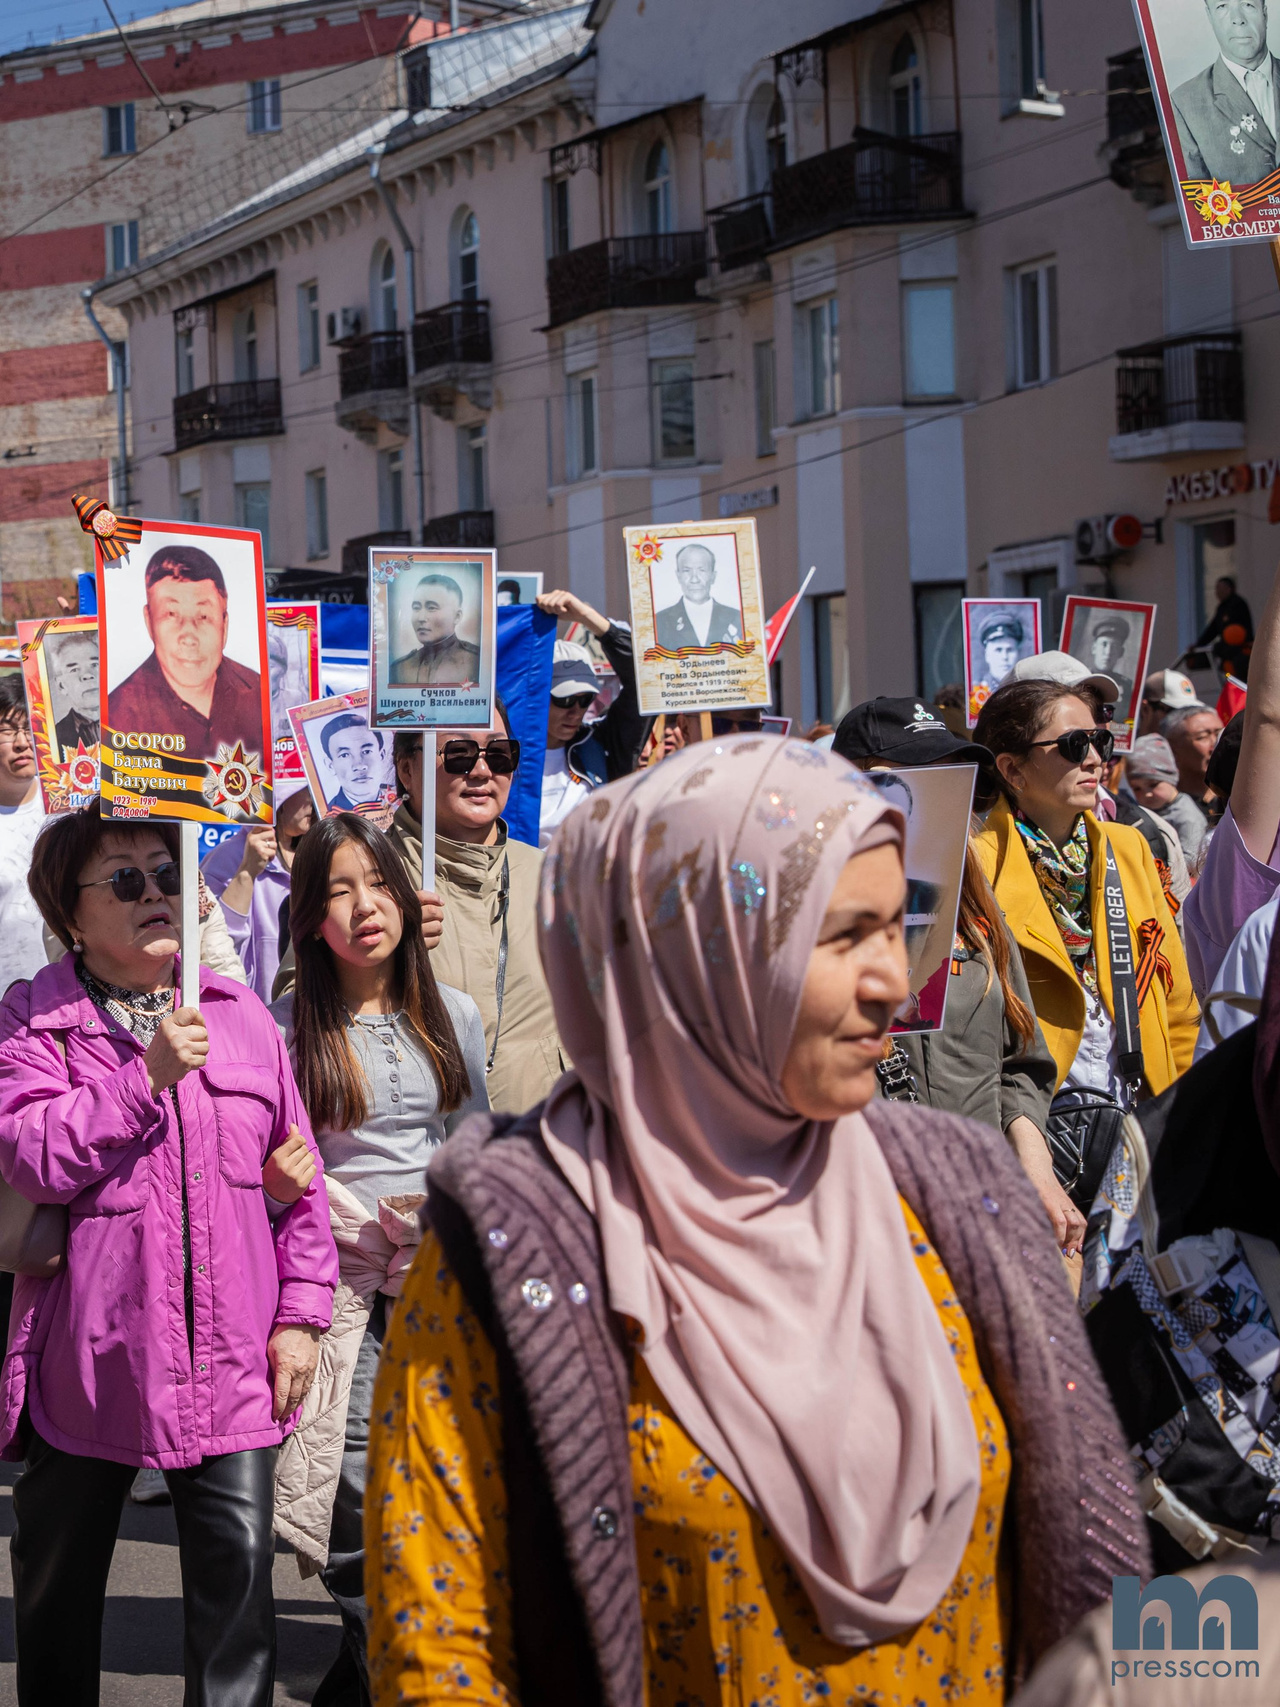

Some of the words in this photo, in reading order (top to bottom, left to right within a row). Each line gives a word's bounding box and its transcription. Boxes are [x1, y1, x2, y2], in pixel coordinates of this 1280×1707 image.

[1267, 194, 1280, 204] Ва
[1201, 219, 1280, 240] БЕССМЕРТ
[679, 658, 726, 669] Эрдынеев
[660, 671, 688, 681] Гарма
[421, 688, 457, 698] Сучков
[380, 698, 426, 708] Ширетор
[429, 698, 487, 707] Васильевич
[112, 732, 186, 751] ОСОРОВ
[273, 740, 295, 752] НОВ
[113, 751, 162, 769] Бадма
[113, 771, 187, 793] Батуевич
[113, 796, 131, 805] 1923
[140, 796, 157, 806] 1989
[112, 806, 150, 818] РЯДОВОЙ
[1106, 885, 1132, 975] LETTIGER
